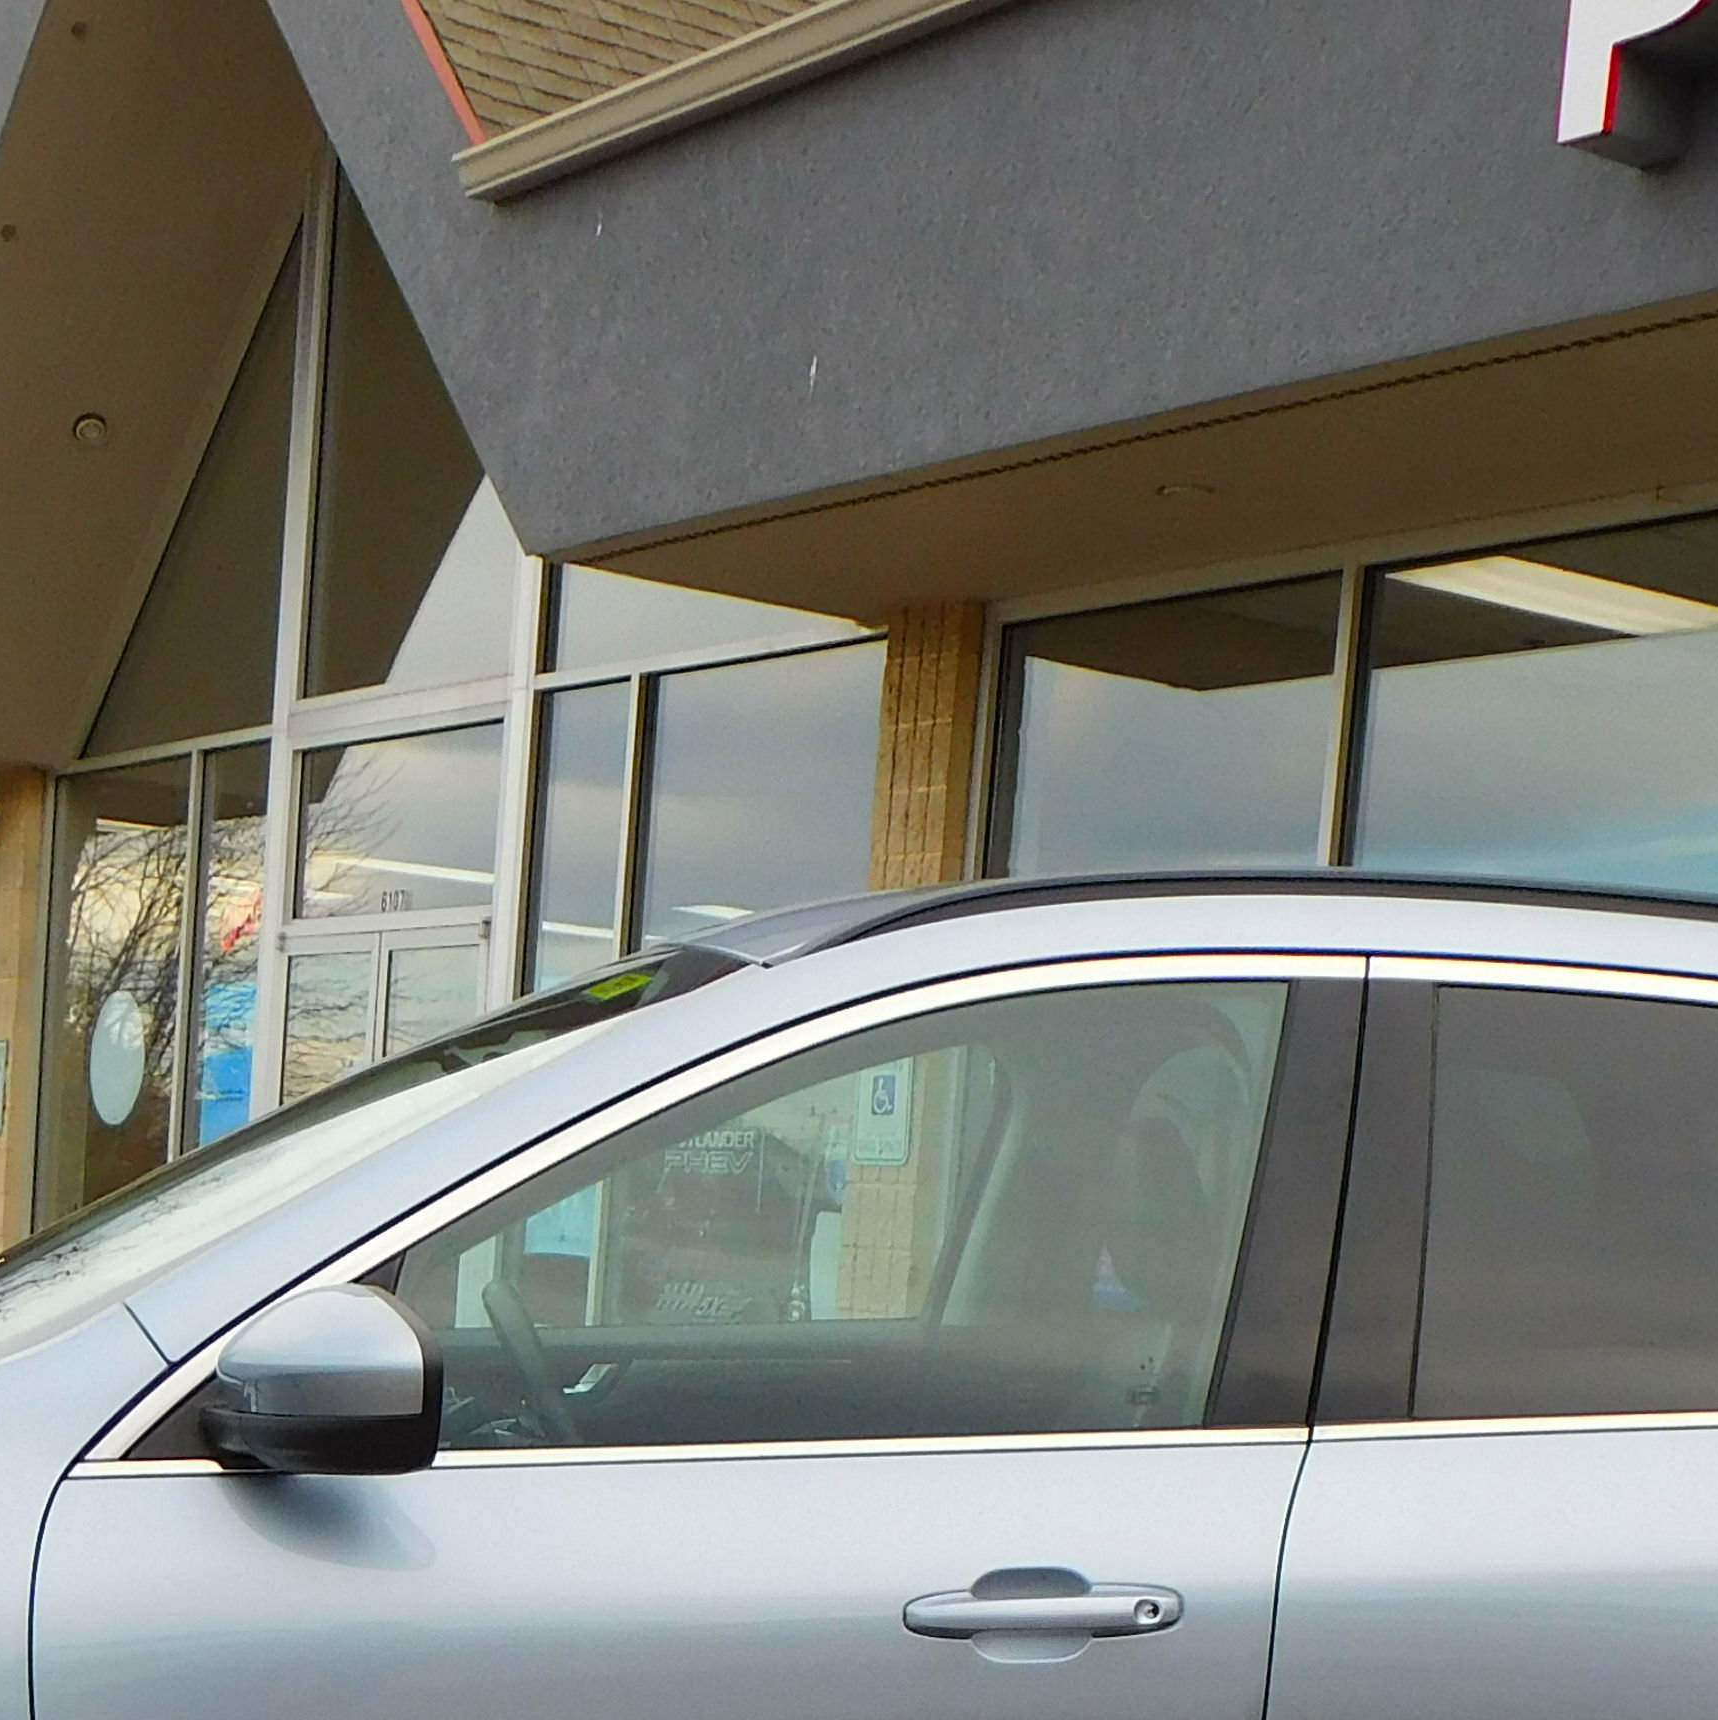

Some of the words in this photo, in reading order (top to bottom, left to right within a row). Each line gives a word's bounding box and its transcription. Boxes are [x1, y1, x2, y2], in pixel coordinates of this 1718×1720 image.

[381, 889, 405, 913] 6107
[677, 1131, 755, 1149] LANDER
[664, 1150, 755, 1175] PHEV
